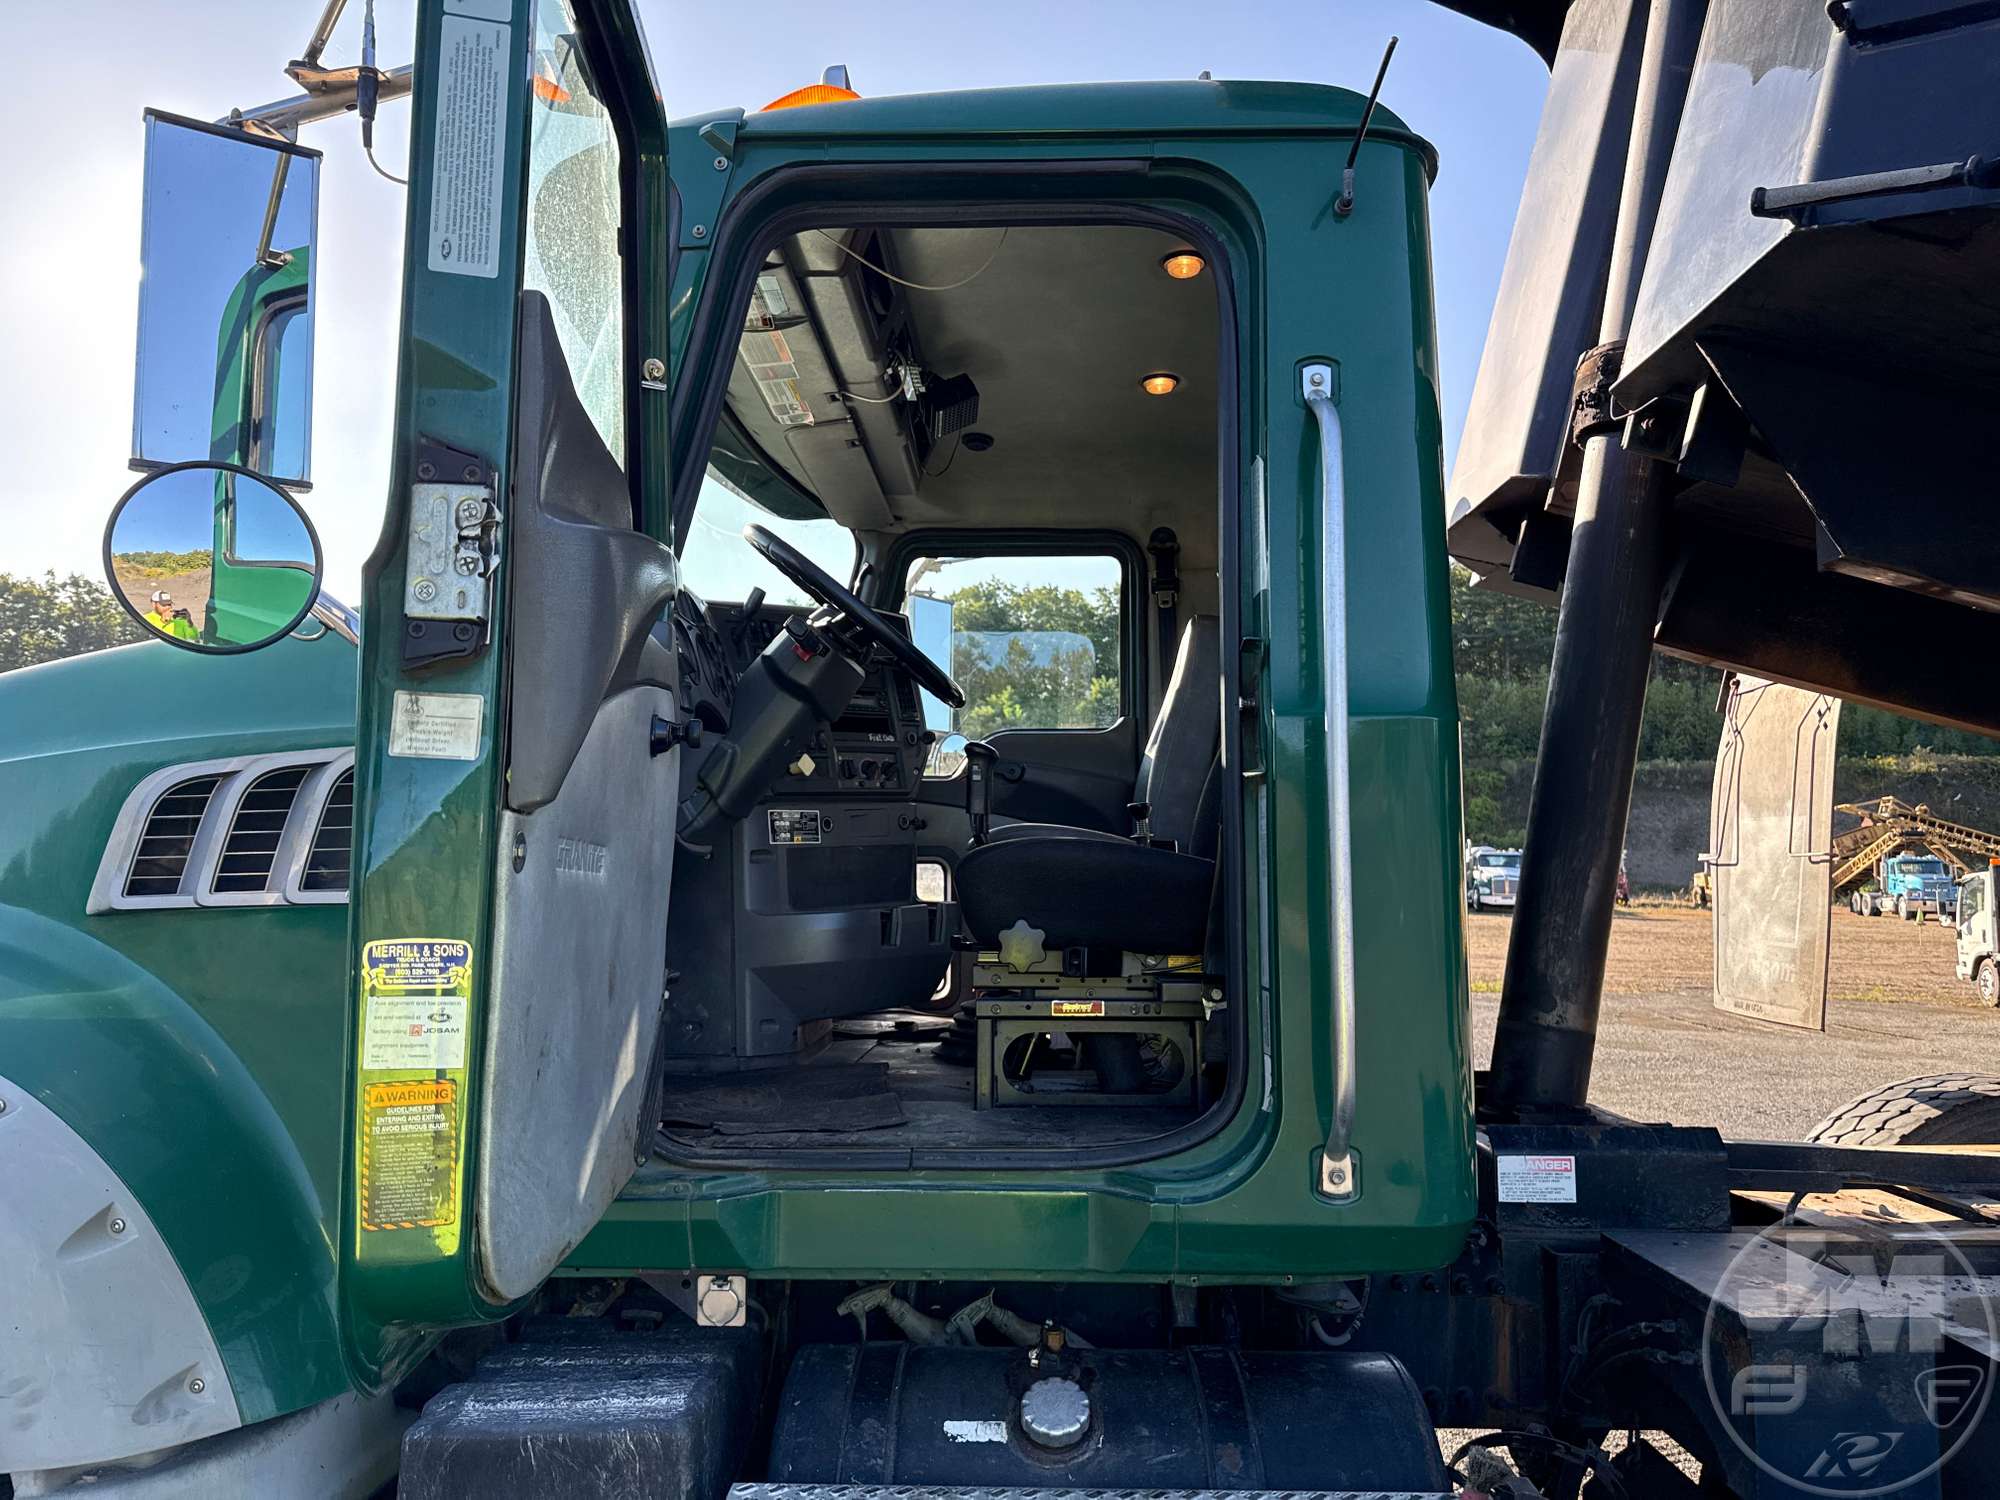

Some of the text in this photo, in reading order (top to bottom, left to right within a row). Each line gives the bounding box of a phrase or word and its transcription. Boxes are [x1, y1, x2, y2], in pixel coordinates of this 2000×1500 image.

[372, 944, 464, 958] MERRILL & SONS
[386, 1088, 449, 1102] WARNING
[386, 1106, 422, 1114] GUIDELINES
[376, 1116, 406, 1124] ENTERING
[422, 1114, 446, 1122] EXITING
[382, 1125, 400, 1133] AVOID
[401, 1124, 428, 1132] SERIOUS
[428, 1122, 450, 1130] INJURY
[1519, 1159, 1570, 1170] ANGER
